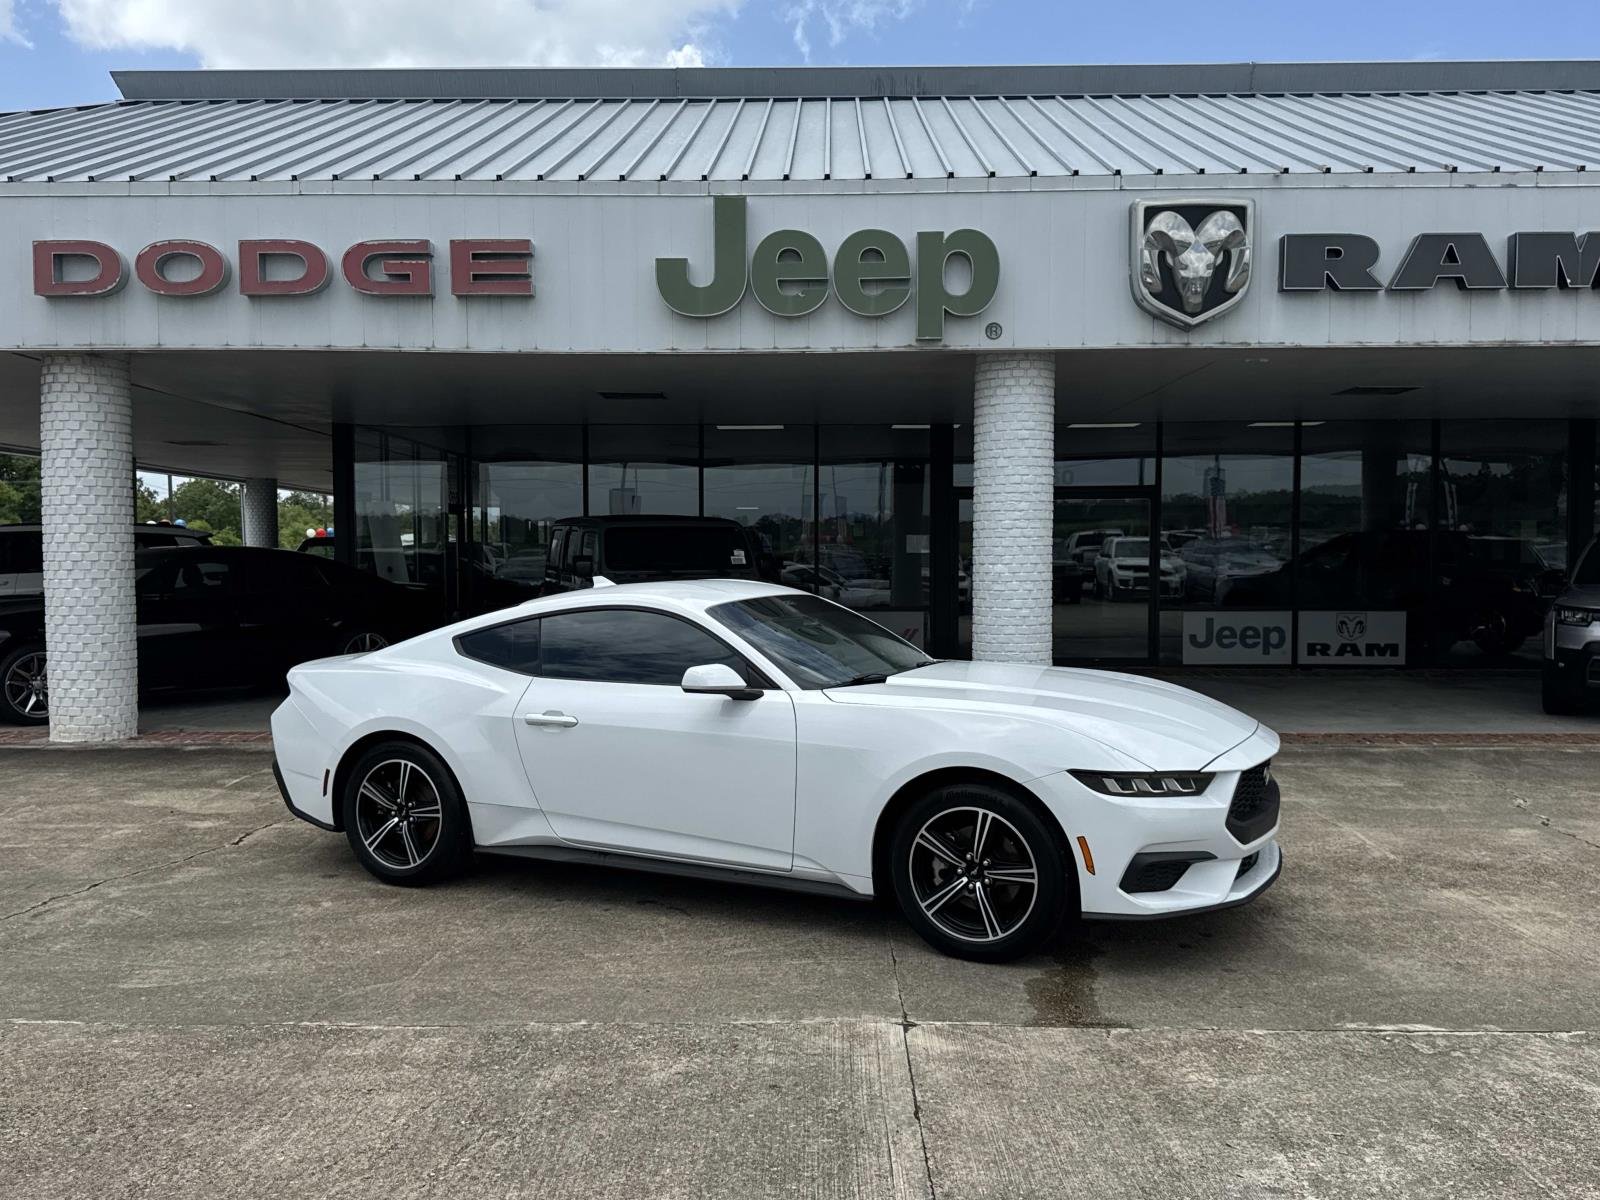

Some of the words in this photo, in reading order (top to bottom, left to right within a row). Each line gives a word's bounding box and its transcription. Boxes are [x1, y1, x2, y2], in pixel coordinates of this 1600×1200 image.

[32, 238, 536, 299] DODGE
[654, 195, 1000, 342] Jeep
[1278, 231, 1600, 292] RAM
[1188, 617, 1287, 656] Jeep
[1306, 642, 1400, 658] RAM
